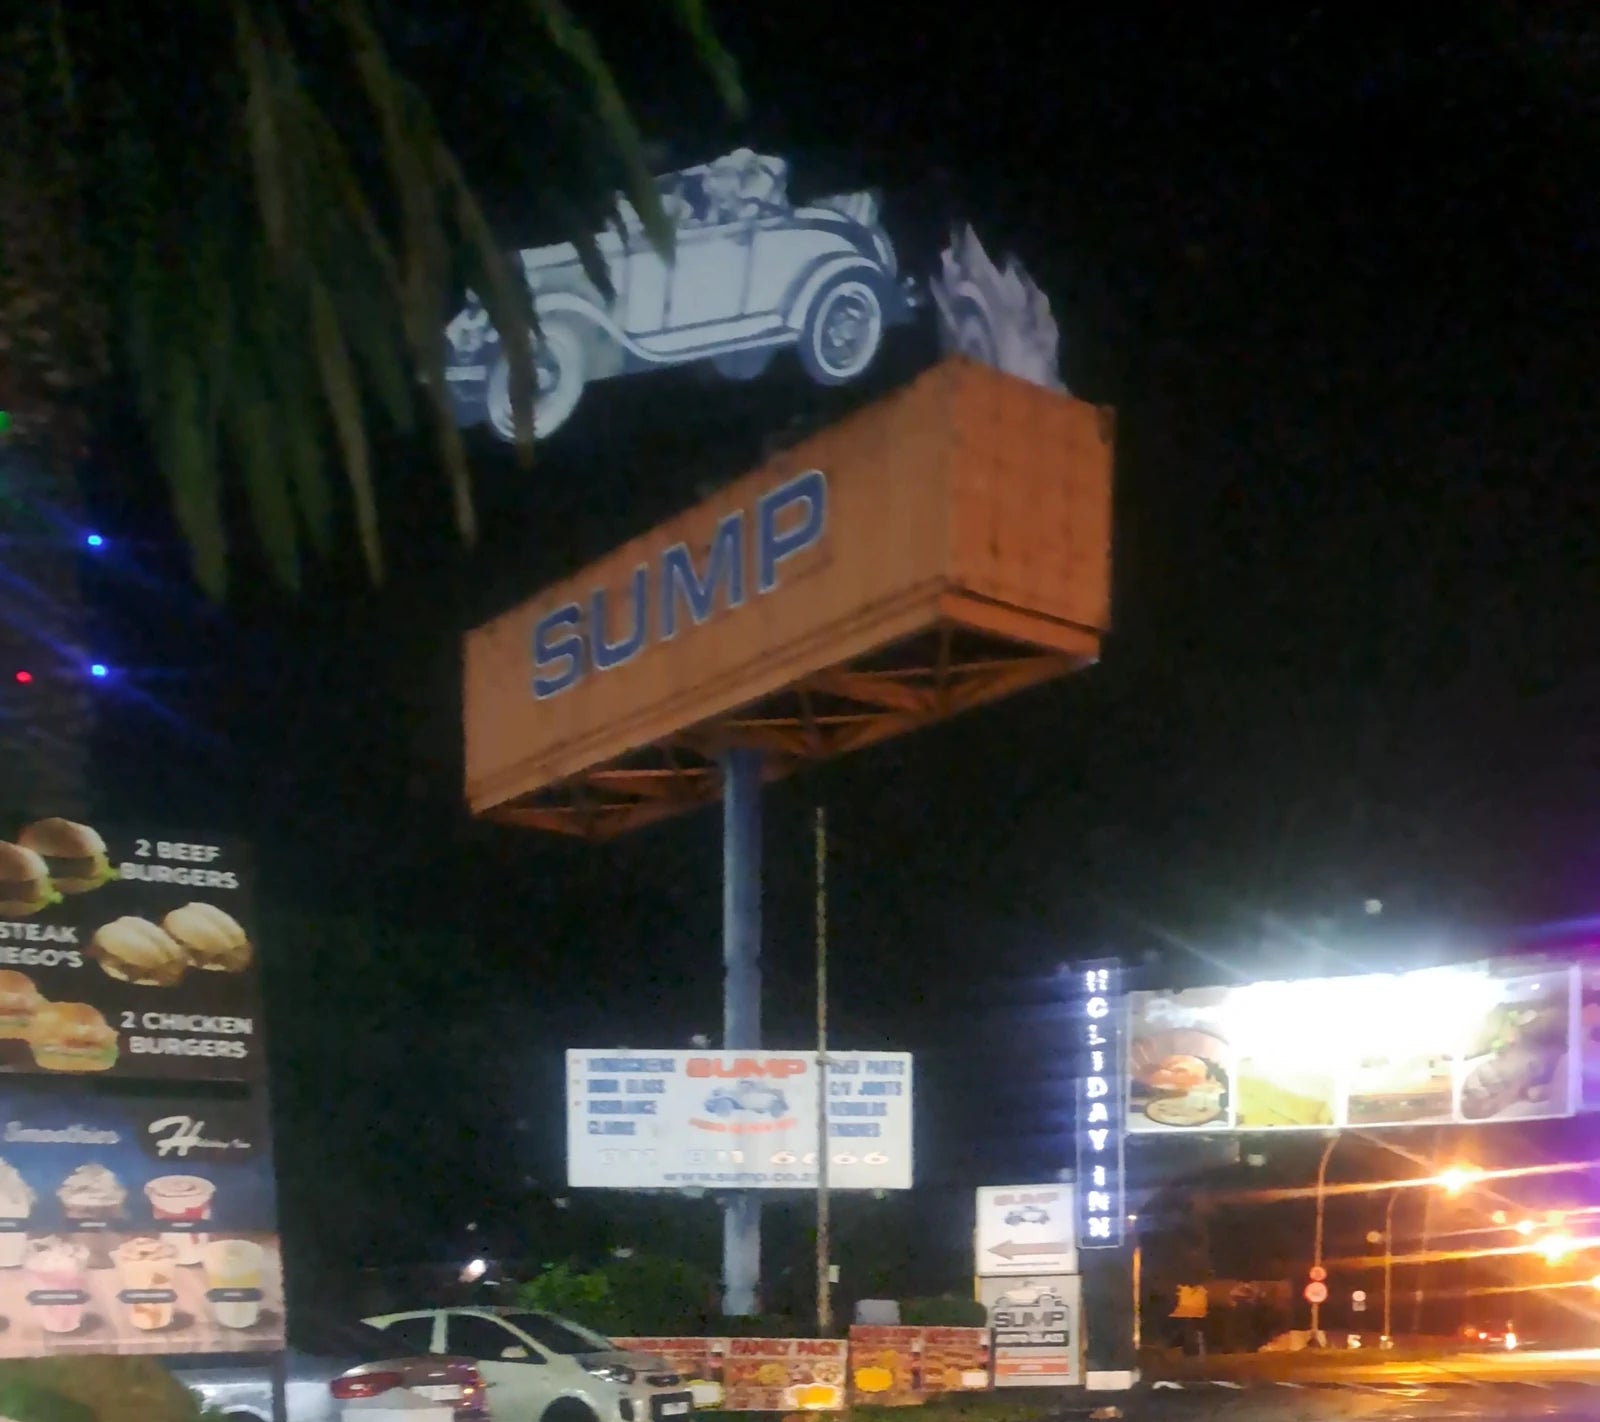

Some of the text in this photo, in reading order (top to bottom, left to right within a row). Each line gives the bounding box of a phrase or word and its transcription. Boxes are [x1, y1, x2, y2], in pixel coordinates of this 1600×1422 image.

[531, 469, 828, 700] SUMP
[134, 839, 220, 862] 2 BEEF
[120, 862, 239, 889] BURGERS
[0, 921, 79, 943] STEAK
[120, 1011, 253, 1035] 2 CHICKEN
[129, 1036, 248, 1058] BURGERS
[686, 1058, 807, 1078] SUMP
[1086, 969, 1110, 1237] HOLIDAY INN
[995, 1311, 1064, 1328] SUMP
